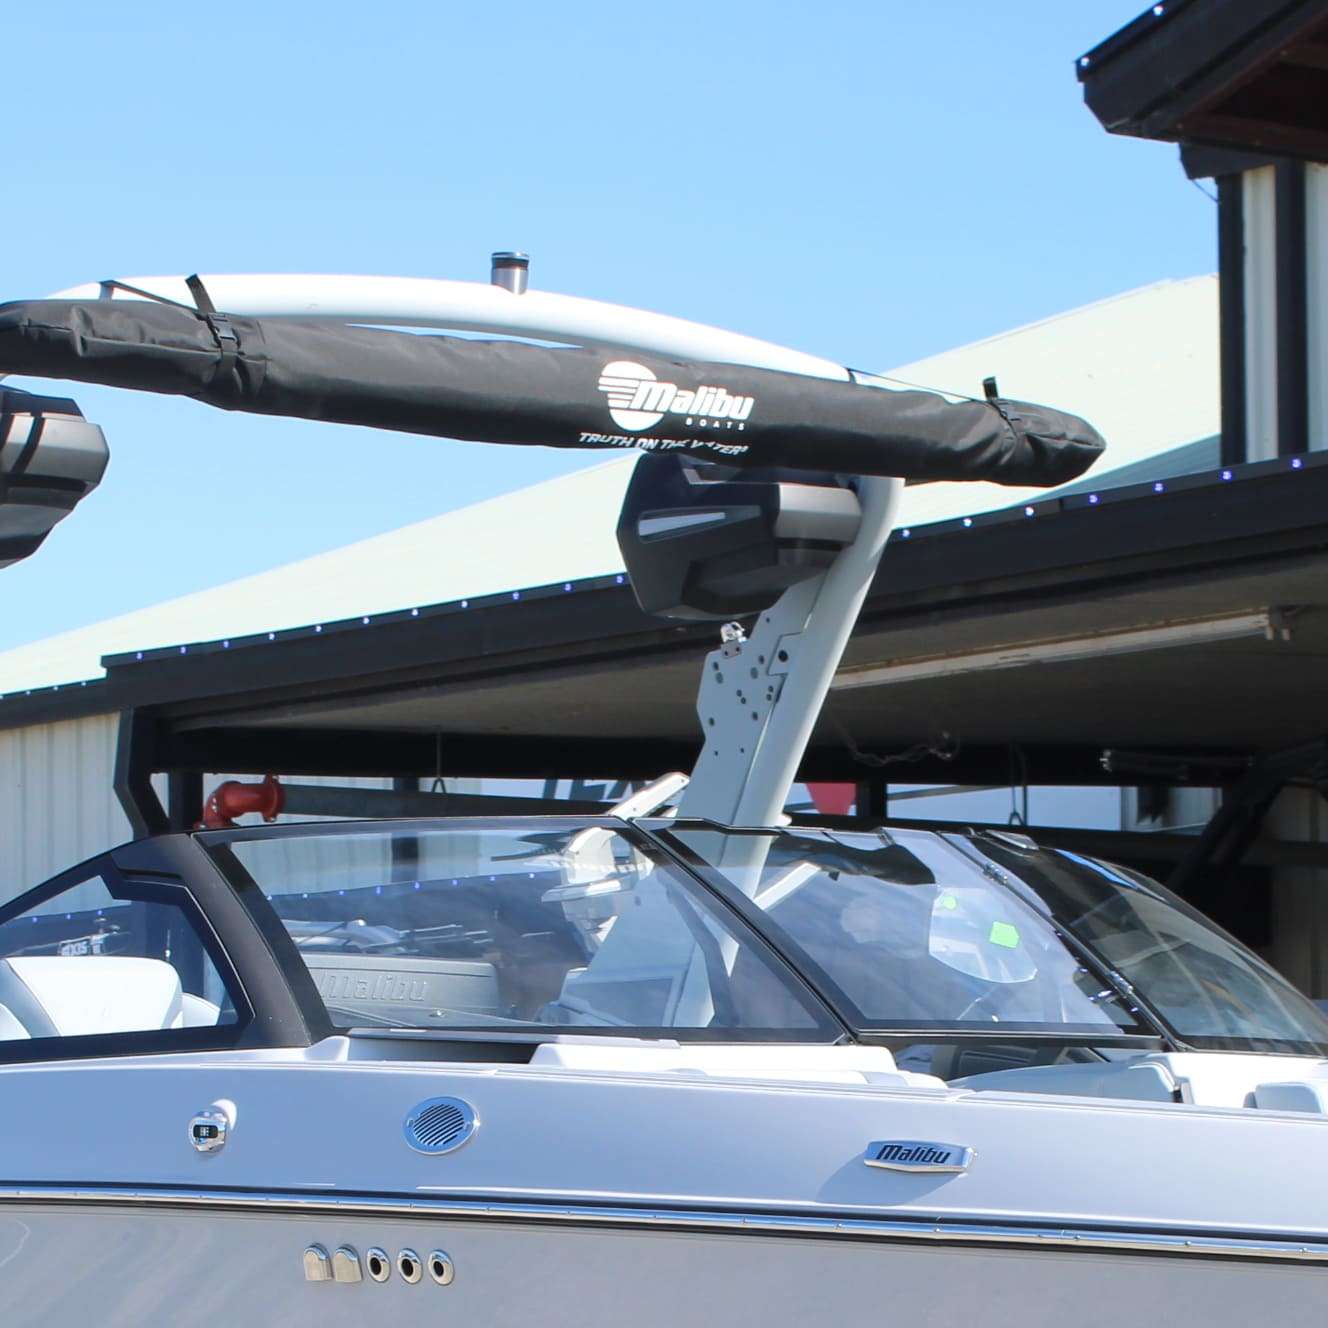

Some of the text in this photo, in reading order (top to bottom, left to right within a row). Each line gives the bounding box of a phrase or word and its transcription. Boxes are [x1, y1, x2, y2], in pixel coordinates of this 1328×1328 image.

[628, 380, 755, 420] Malibu
[685, 417, 745, 431] BOATS
[578, 432, 634, 447] TRUTH
[634, 438, 660, 450] ON
[875, 1144, 952, 1164] Malibu
